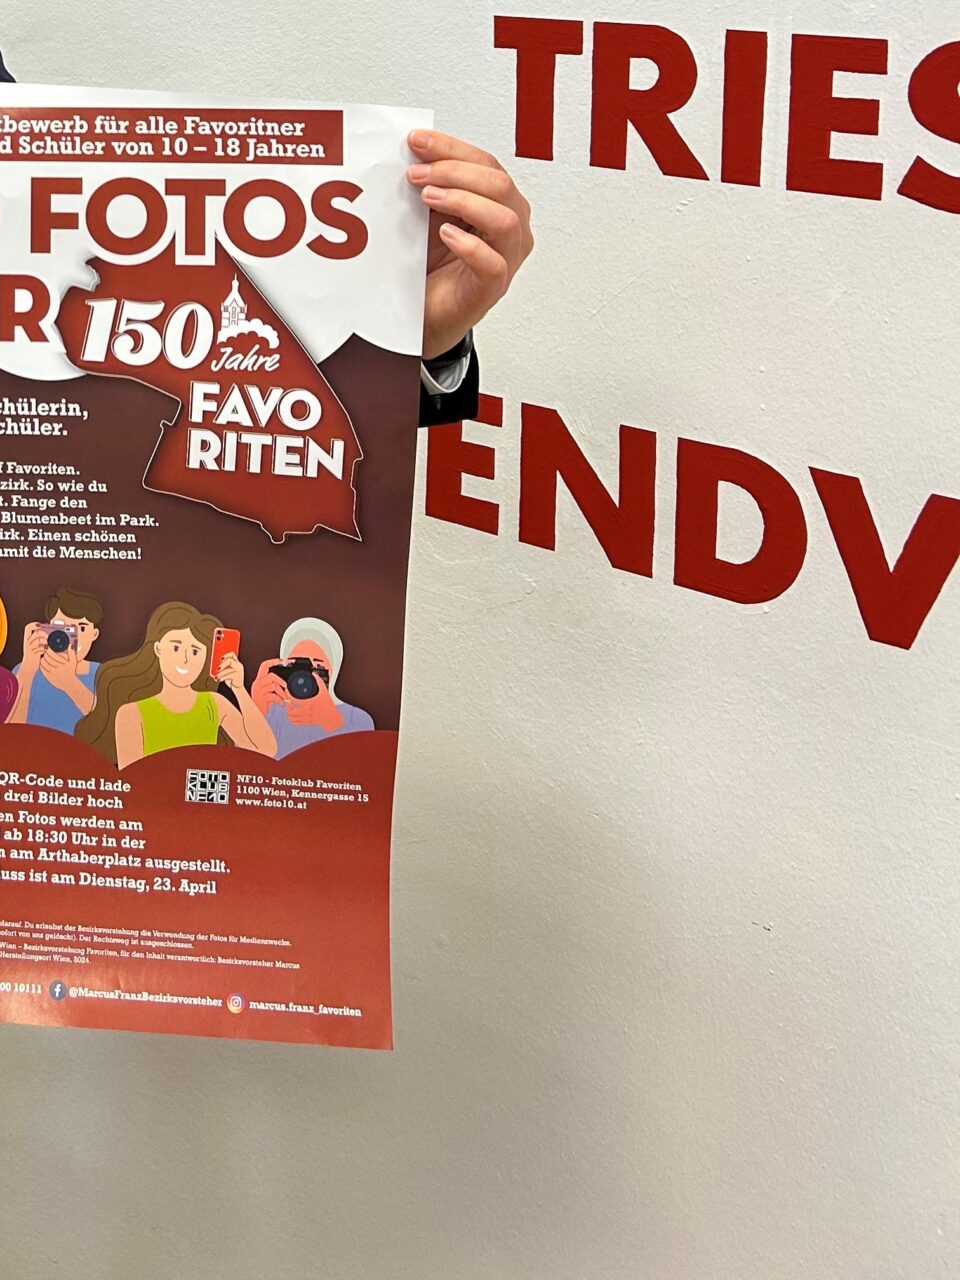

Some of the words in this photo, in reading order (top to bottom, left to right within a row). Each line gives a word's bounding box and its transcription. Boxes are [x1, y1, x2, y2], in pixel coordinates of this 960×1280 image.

[94, 116, 129, 134] für
[134, 116, 178, 134] alle
[183, 116, 305, 136] Favoritner
[18, 136, 105, 155] Schüler
[111, 141, 154, 155] von
[162, 137, 188, 155] 10
[214, 137, 240, 156] 18
[246, 138, 325, 161] Jahren
[30, 177, 368, 260] FOTOS
[80, 297, 214, 369] 150
[210, 344, 280, 371] Jahre
[189, 380, 322, 431] FAVO
[186, 427, 344, 481] RITEN
[6, 461, 80, 475] Favoriten.
[36, 478, 53, 491] So
[57, 479, 84, 492] wie
[87, 479, 107, 492] du
[10, 494, 56, 510] Fange
[59, 495, 87, 508] den
[0, 511, 91, 525] Blumenbeet
[95, 513, 116, 525] im
[119, 513, 159, 526] Park.
[27, 528, 71, 541] Einen
[74, 529, 136, 542] schönen
[32, 545, 56, 558] die
[59, 545, 141, 559] Menschen!
[67, 777, 96, 790] und
[99, 778, 131, 792] lade
[236, 774, 263, 784] NF10
[271, 776, 314, 787] Fotoklub
[315, 779, 361, 791] Favoriten
[3, 789, 34, 803] drei
[37, 791, 83, 806] Bilder
[86, 794, 123, 809] hoch
[235, 798, 307, 809] www.foto10.at
[237, 786, 260, 795] 1100
[261, 787, 289, 798] Wien,
[291, 789, 354, 801] Kennergasse
[357, 793, 368, 802] 15
[17, 810, 56, 825] Fotos
[59, 815, 115, 829] werden
[118, 820, 143, 831] am
[3, 827, 22, 841] ab
[27, 828, 67, 844] 18:30
[71, 831, 98, 846] Uhr
[101, 833, 117, 847] in
[120, 835, 146, 849] der
[9, 848, 34, 860] am
[37, 847, 141, 868] Arthaberplatz
[144, 857, 230, 873] ausgestellt.
[28, 868, 47, 882] ist
[50, 873, 75, 884] am
[78, 871, 149, 892] Dienstag,
[153, 876, 175, 891] 23.
[178, 878, 216, 896] April
[13, 983, 41, 994] 10111
[68, 987, 222, 1006] @MarcusFranzBezirksvorsteher
[249, 1001, 361, 1016] marcus.franz_favoriten
